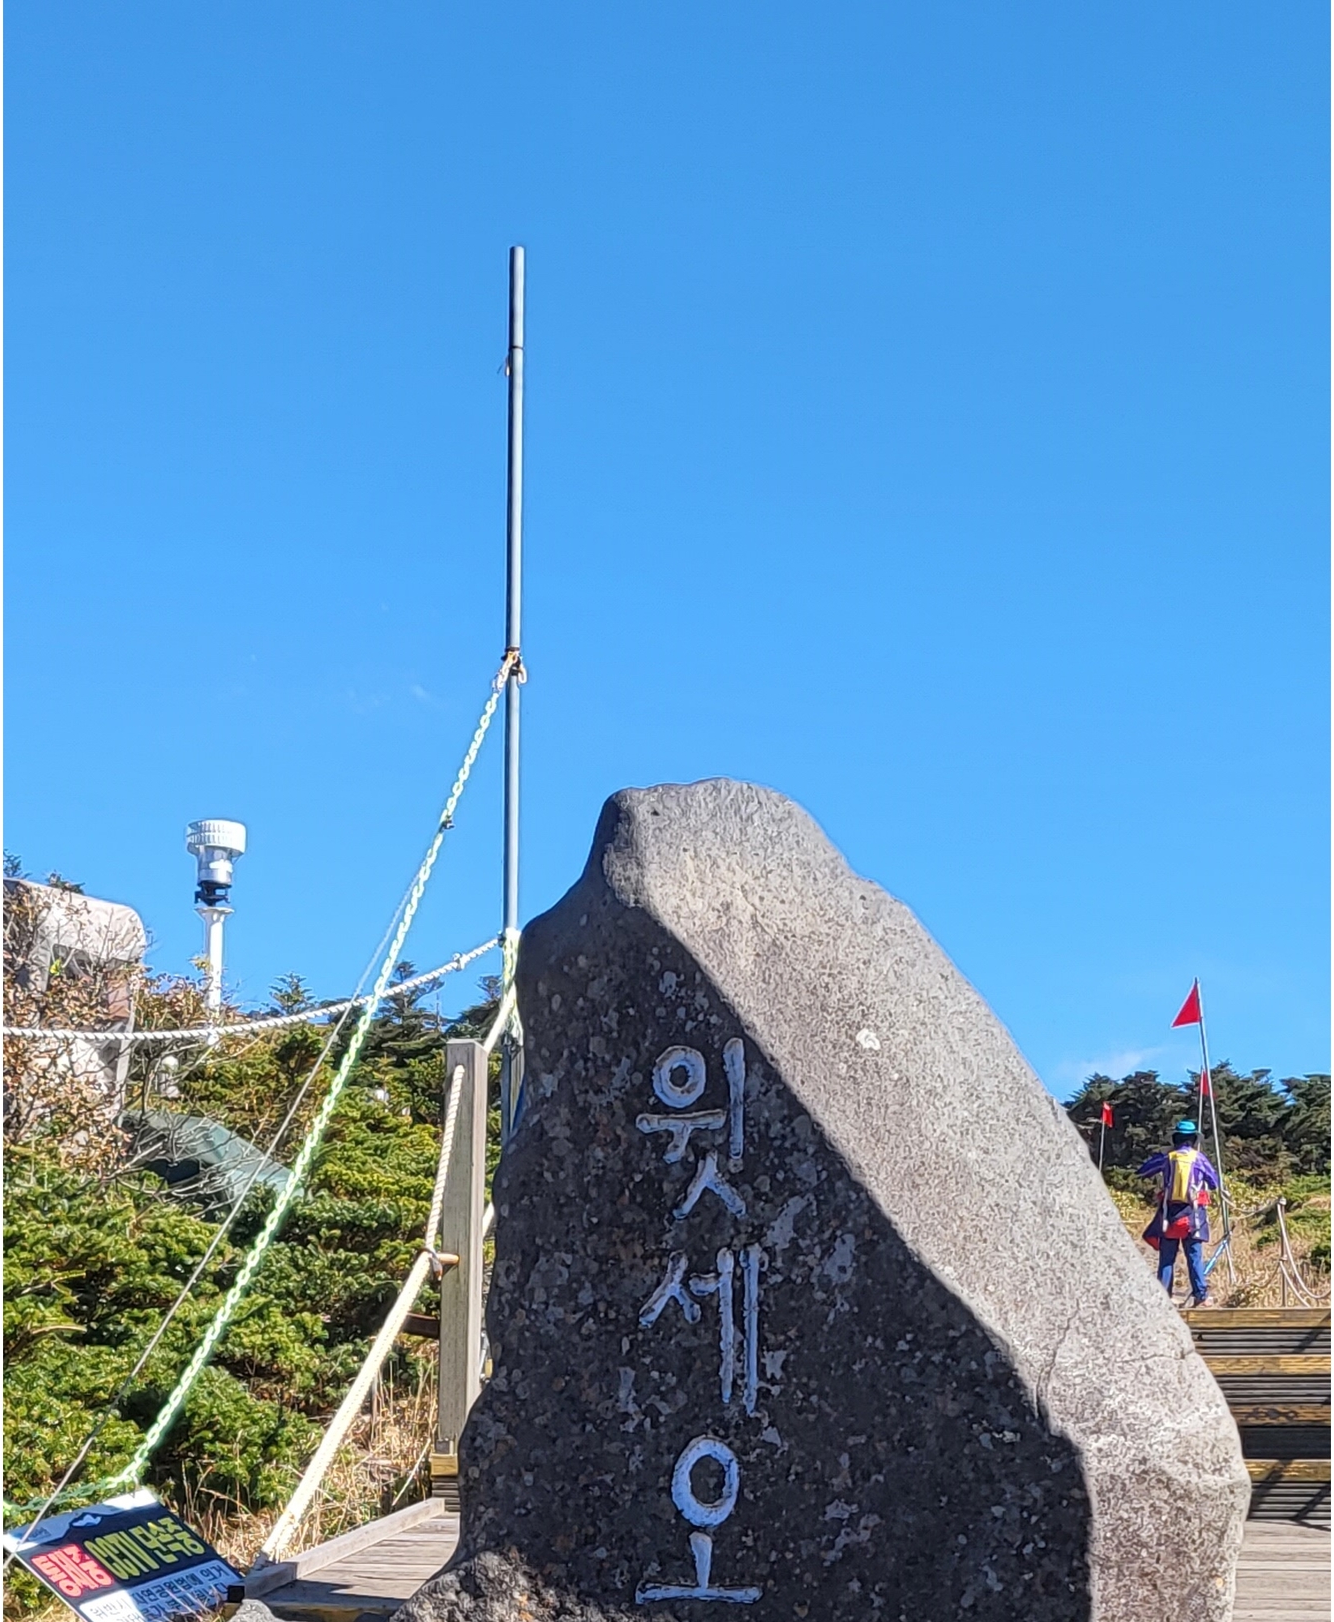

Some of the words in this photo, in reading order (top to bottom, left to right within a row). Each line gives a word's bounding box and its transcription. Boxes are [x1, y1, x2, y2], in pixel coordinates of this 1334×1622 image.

[31, 1544, 113, 1597] 통제중
[83, 1531, 160, 1579] CCTV
[128, 1516, 206, 1563] 단속중
[199, 1565, 229, 1582] 의거
